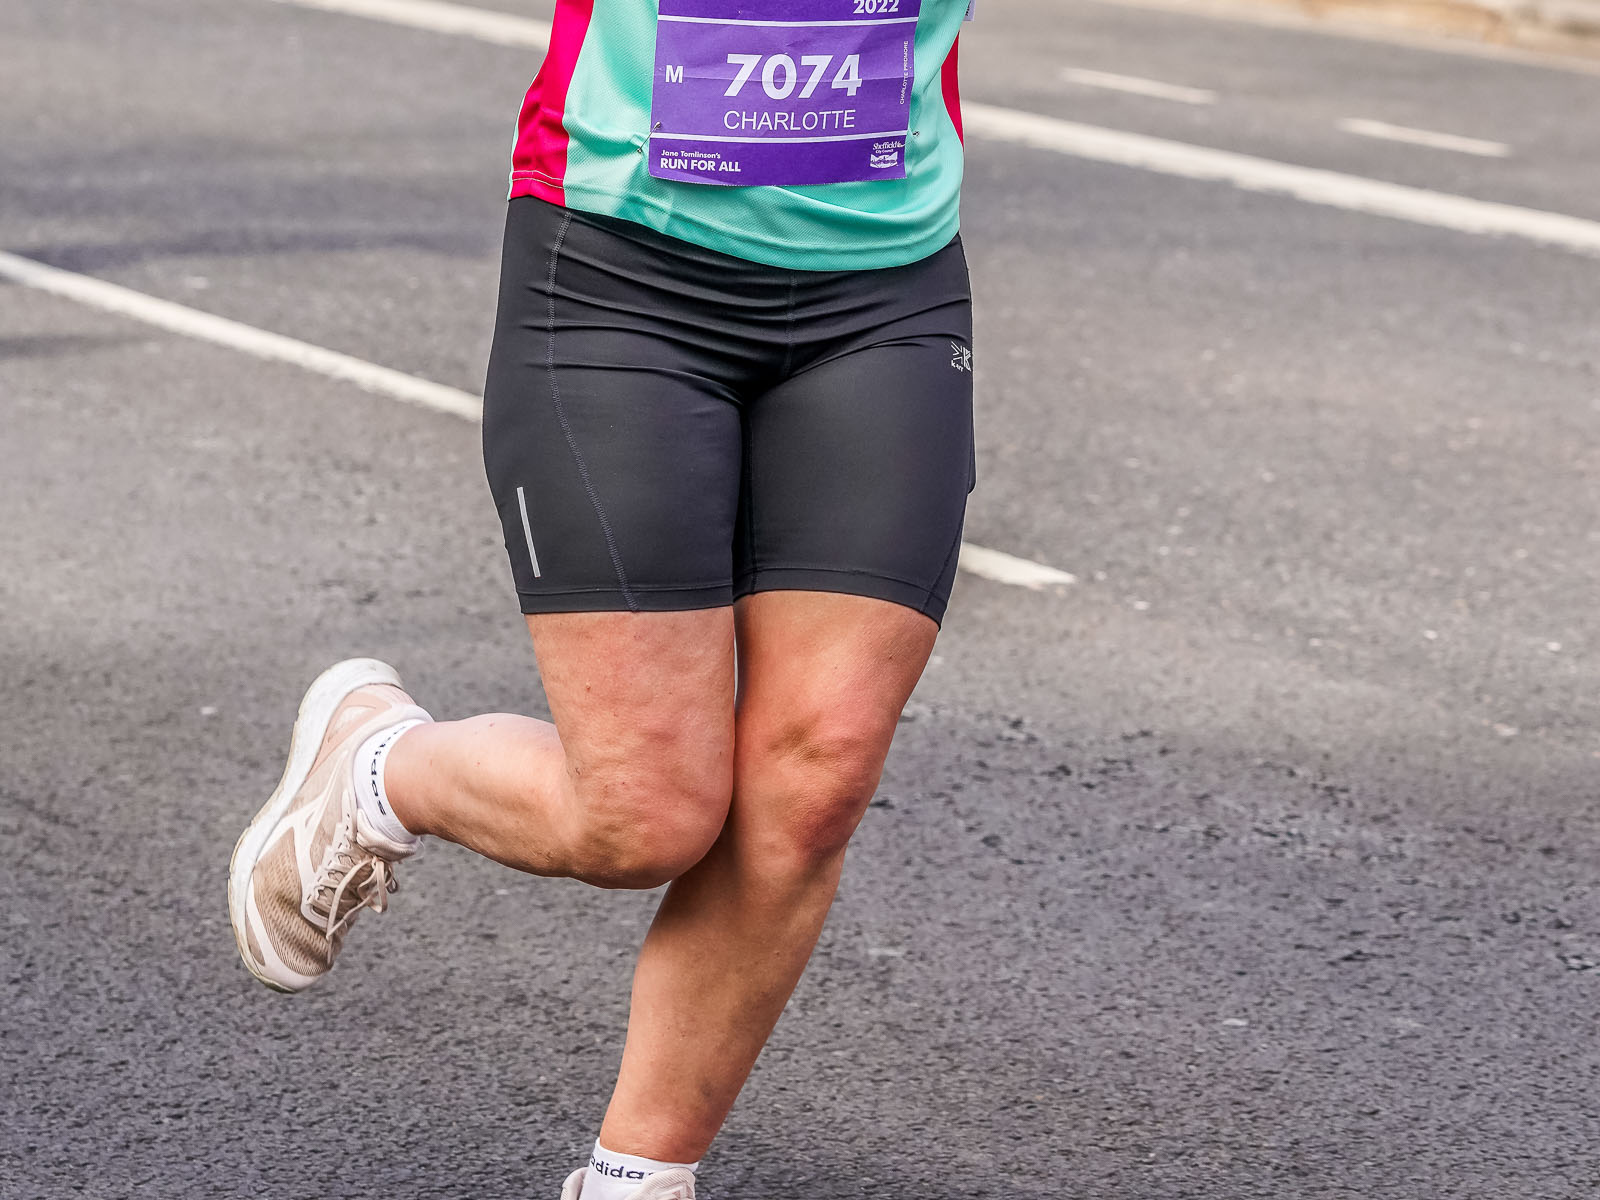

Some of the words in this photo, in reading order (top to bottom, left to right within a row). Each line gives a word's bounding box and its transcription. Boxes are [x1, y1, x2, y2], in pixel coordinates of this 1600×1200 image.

[665, 64, 684, 83] M
[723, 53, 863, 100] 7074
[723, 109, 856, 131] CHARLOTTE
[660, 157, 688, 170] RUN
[690, 159, 716, 171] FOR
[718, 161, 741, 172] ALL
[661, 149, 679, 157] Jane
[680, 150, 721, 159] Tomlinson's
[590, 1154, 655, 1179] adida
